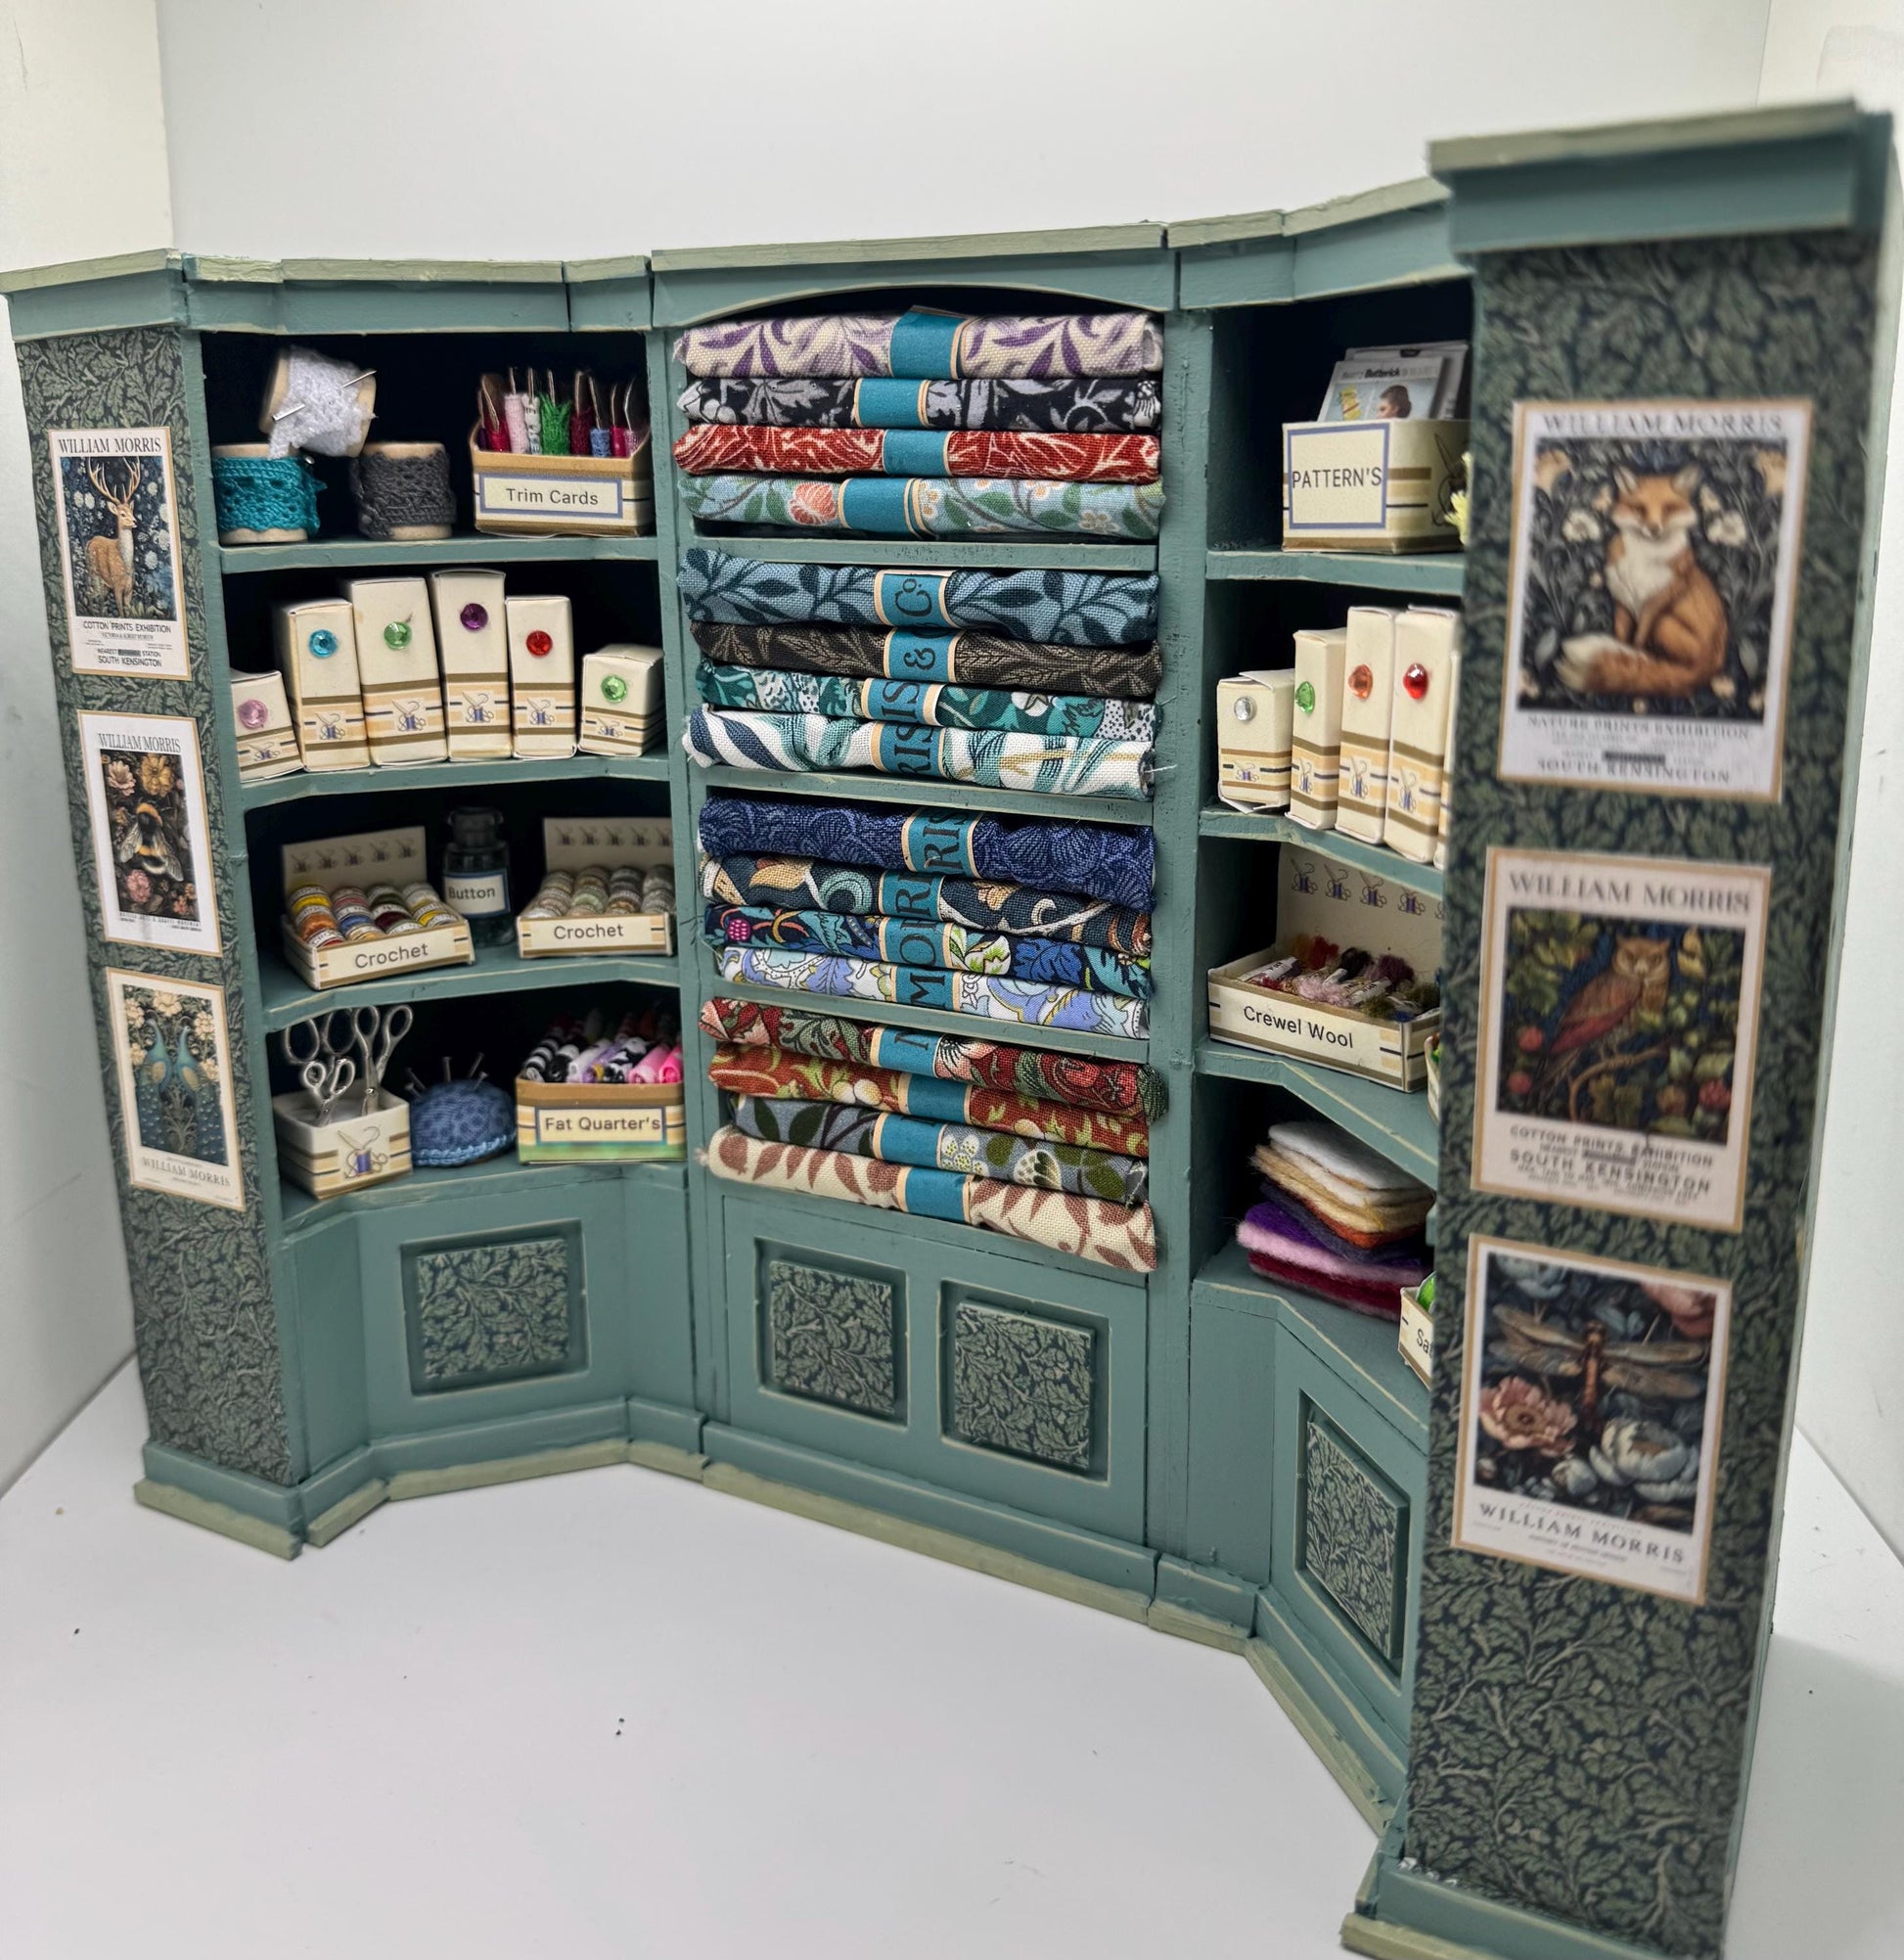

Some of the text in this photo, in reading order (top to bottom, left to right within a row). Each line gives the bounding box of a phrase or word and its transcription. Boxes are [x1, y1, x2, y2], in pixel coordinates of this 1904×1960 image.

[1543, 412, 1784, 435] WILLIAM MORRIS
[59, 436, 162, 454] WILLIAM MORRIS
[1292, 466, 1383, 489] PATTERN'S
[506, 487, 599, 505] Trim Cards
[83, 620, 172, 634] COTTON PRINTS EXHIBITION
[98, 656, 162, 667] SOUTH KENSINGTON
[98, 733, 182, 752] WILLIAM MORRIS
[447, 886, 497, 901] Button
[1509, 871, 1750, 914] WILLIAM MORRIS
[554, 924, 624, 939] Crochet
[354, 942, 430, 969] Crochet
[1243, 1005, 1354, 1049] Crewel Wool
[545, 1117, 661, 1131] Fat Quarter's
[1510, 1125, 1566, 1143] COTTON
[1573, 1135, 1623, 1154] PRINTS
[141, 1157, 186, 1176] WILLIAM
[189, 1168, 231, 1187] MORRIS
[1510, 1148, 1574, 1171] SOUTH
[1584, 1160, 1710, 1194] KENSINGTON
[1478, 1502, 1582, 1539] WILLIAM
[1591, 1529, 1686, 1564] MORRIS
